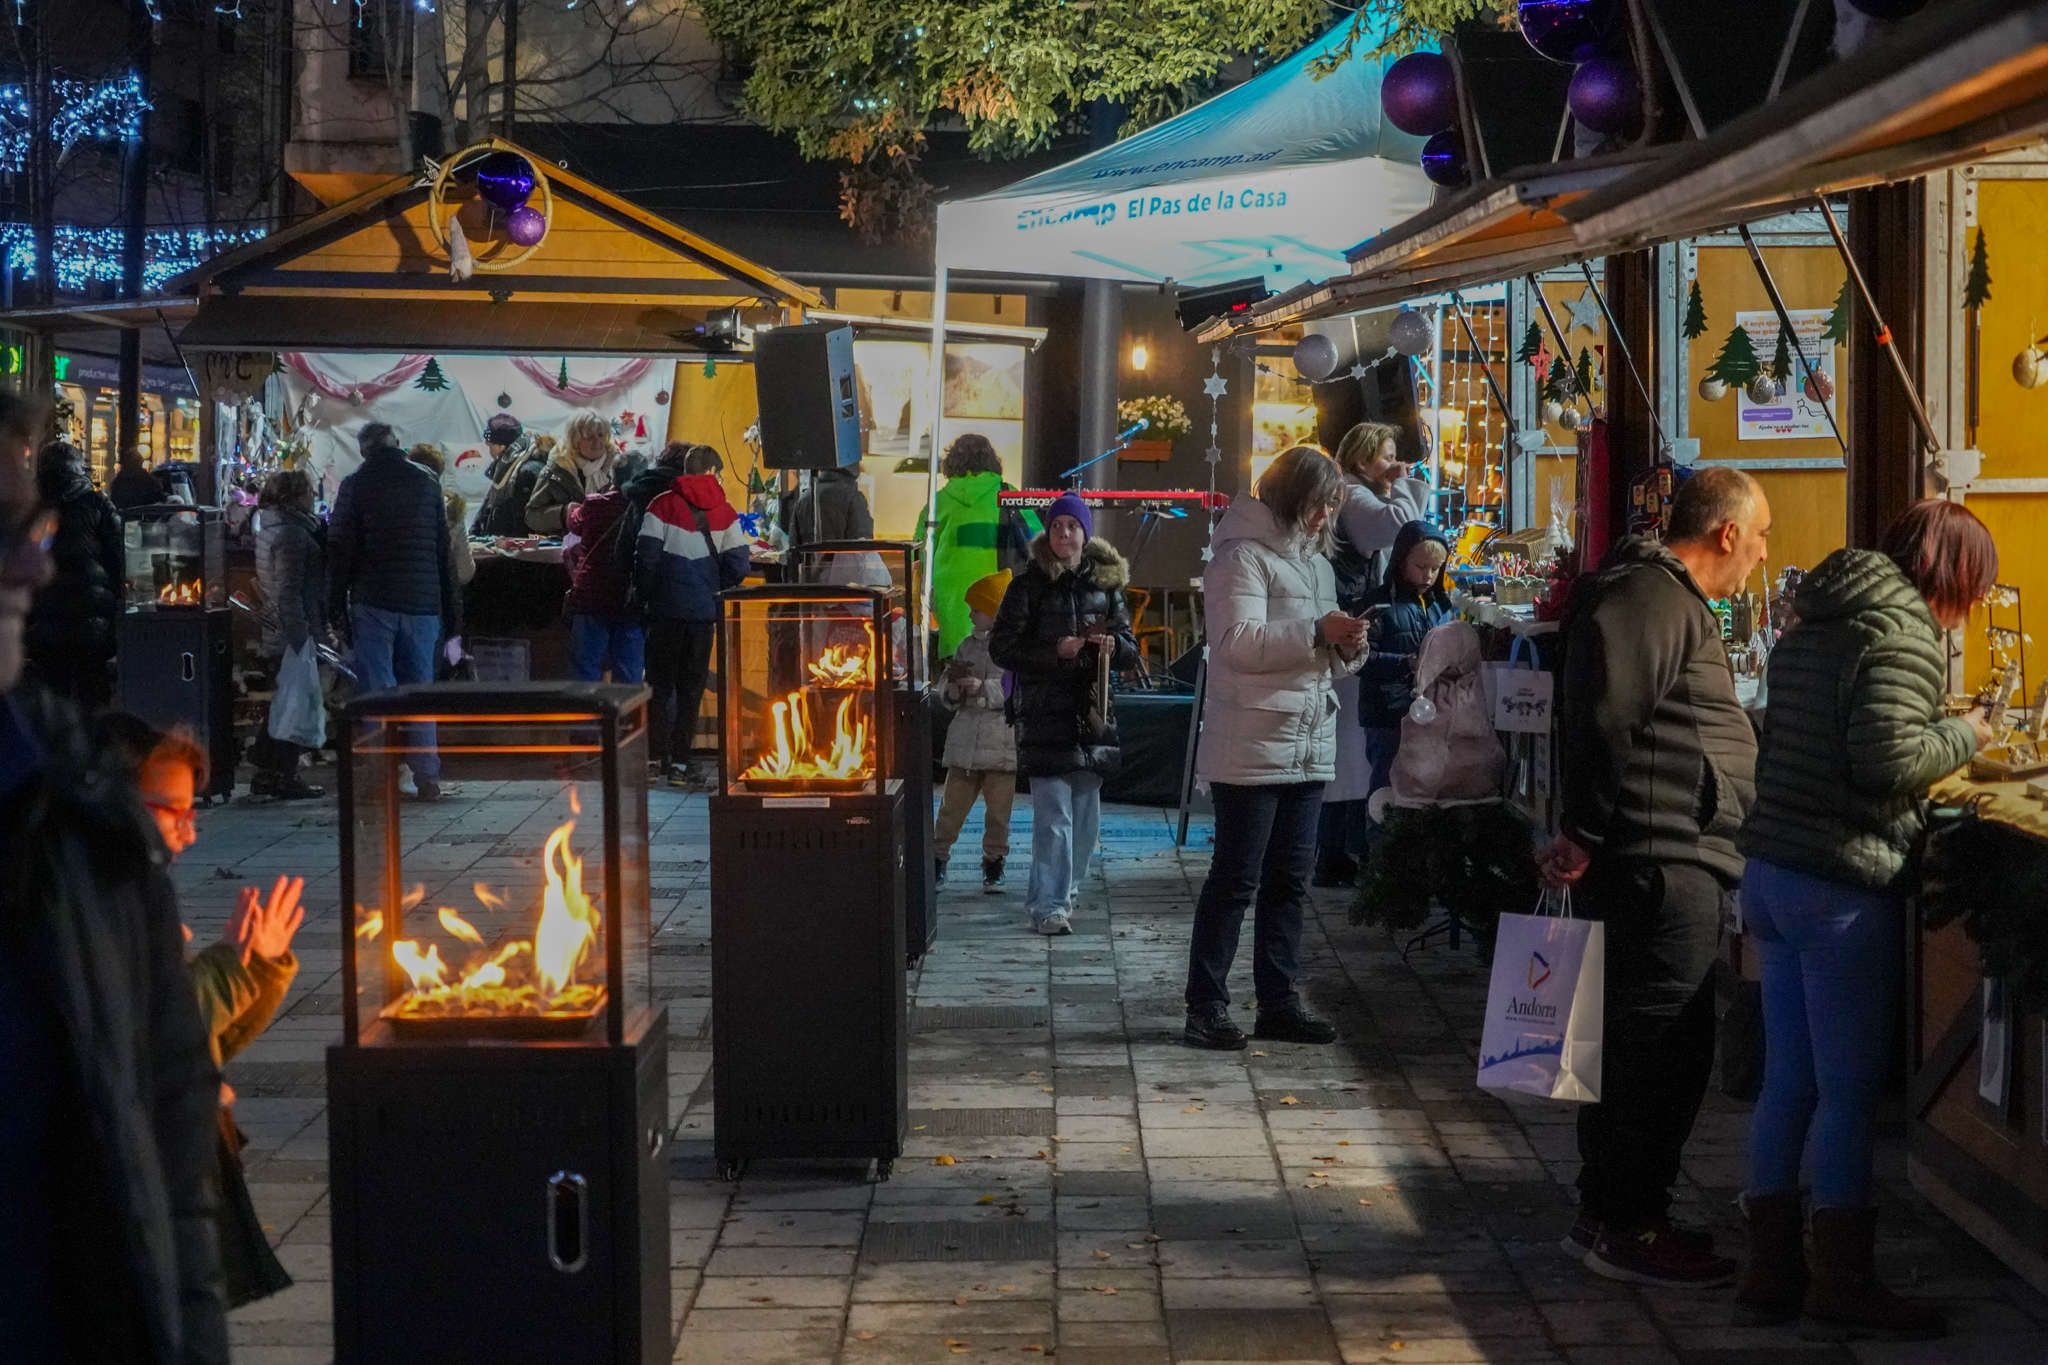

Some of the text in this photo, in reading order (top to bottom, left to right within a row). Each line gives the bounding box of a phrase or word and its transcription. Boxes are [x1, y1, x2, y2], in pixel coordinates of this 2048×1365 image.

[1093, 149, 1284, 180] www.encamp.ad
[1128, 198, 1143, 219] El
[1149, 197, 1181, 217] Pas
[1187, 193, 1211, 213] de
[1217, 190, 1233, 210] la
[1240, 189, 1287, 209] Casa
[1001, 497, 1023, 506] nord
[1506, 996, 1556, 1018] Andorra
